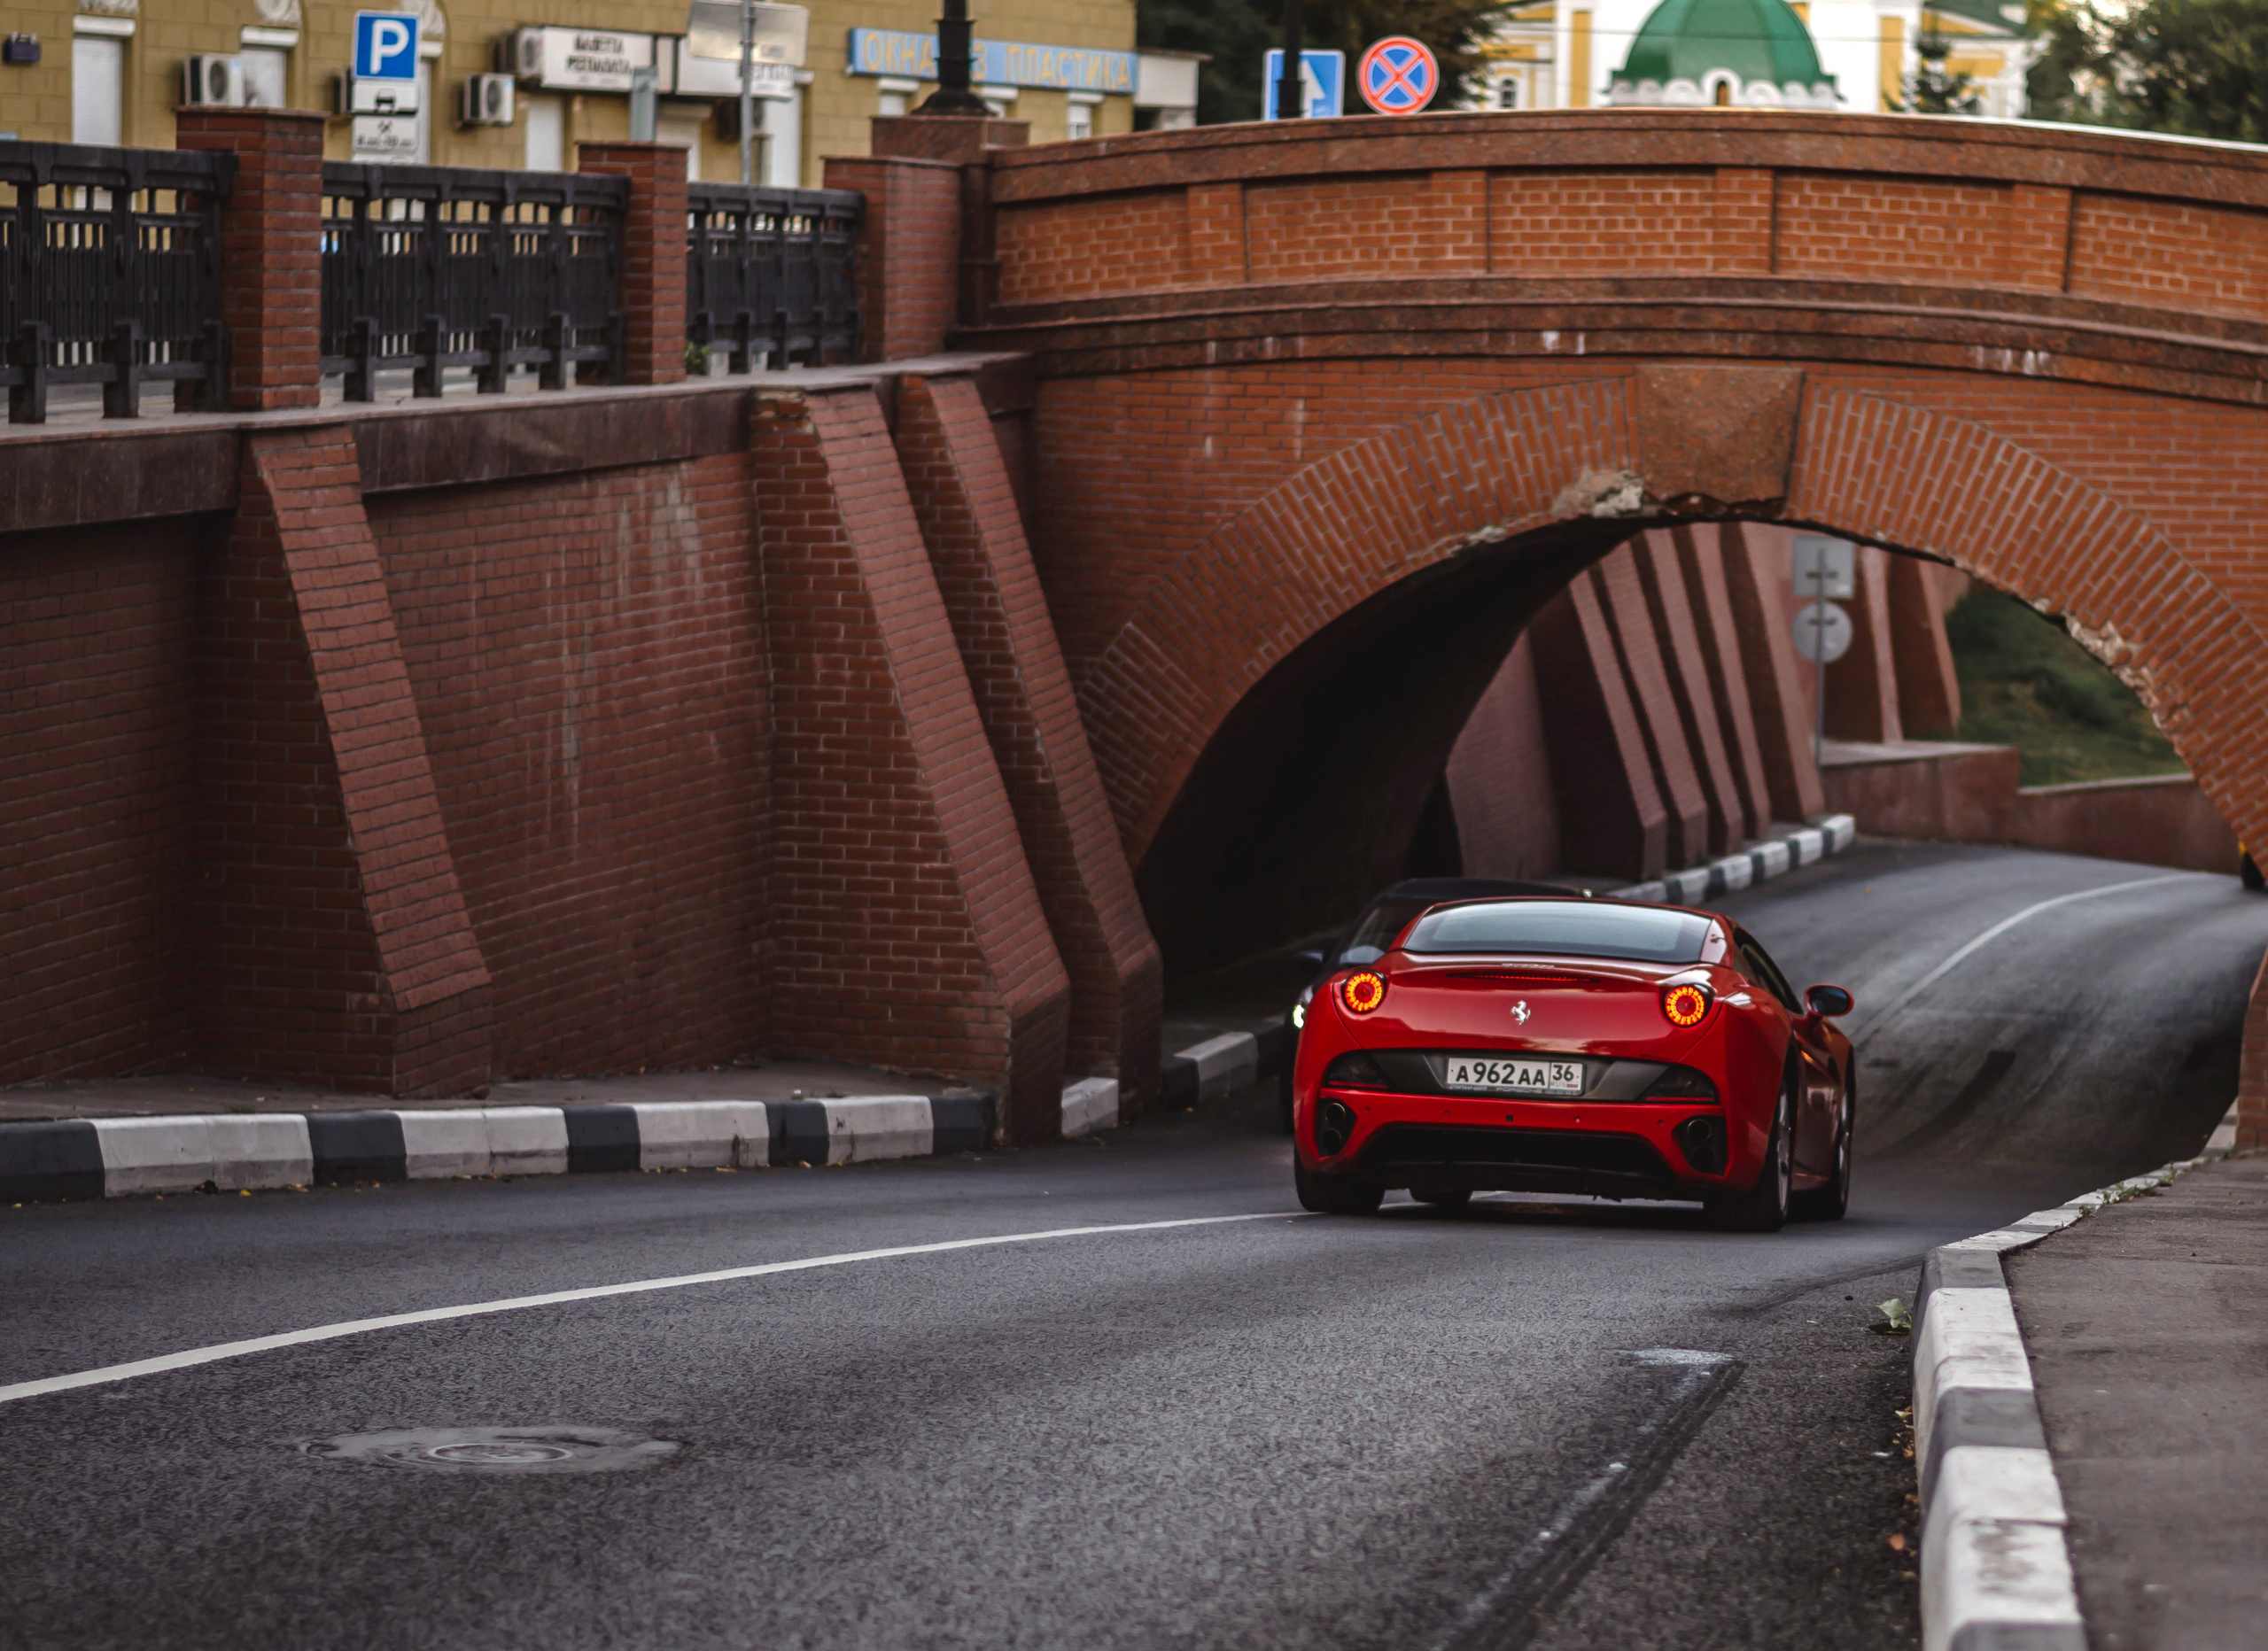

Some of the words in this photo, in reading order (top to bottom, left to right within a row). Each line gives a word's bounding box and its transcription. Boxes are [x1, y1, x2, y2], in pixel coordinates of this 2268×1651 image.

[369, 19, 410, 75] P
[863, 32, 939, 78] ОКНА
[1005, 43, 1132, 91] ПЛАСТИКА
[1552, 1064, 1575, 1081] 36
